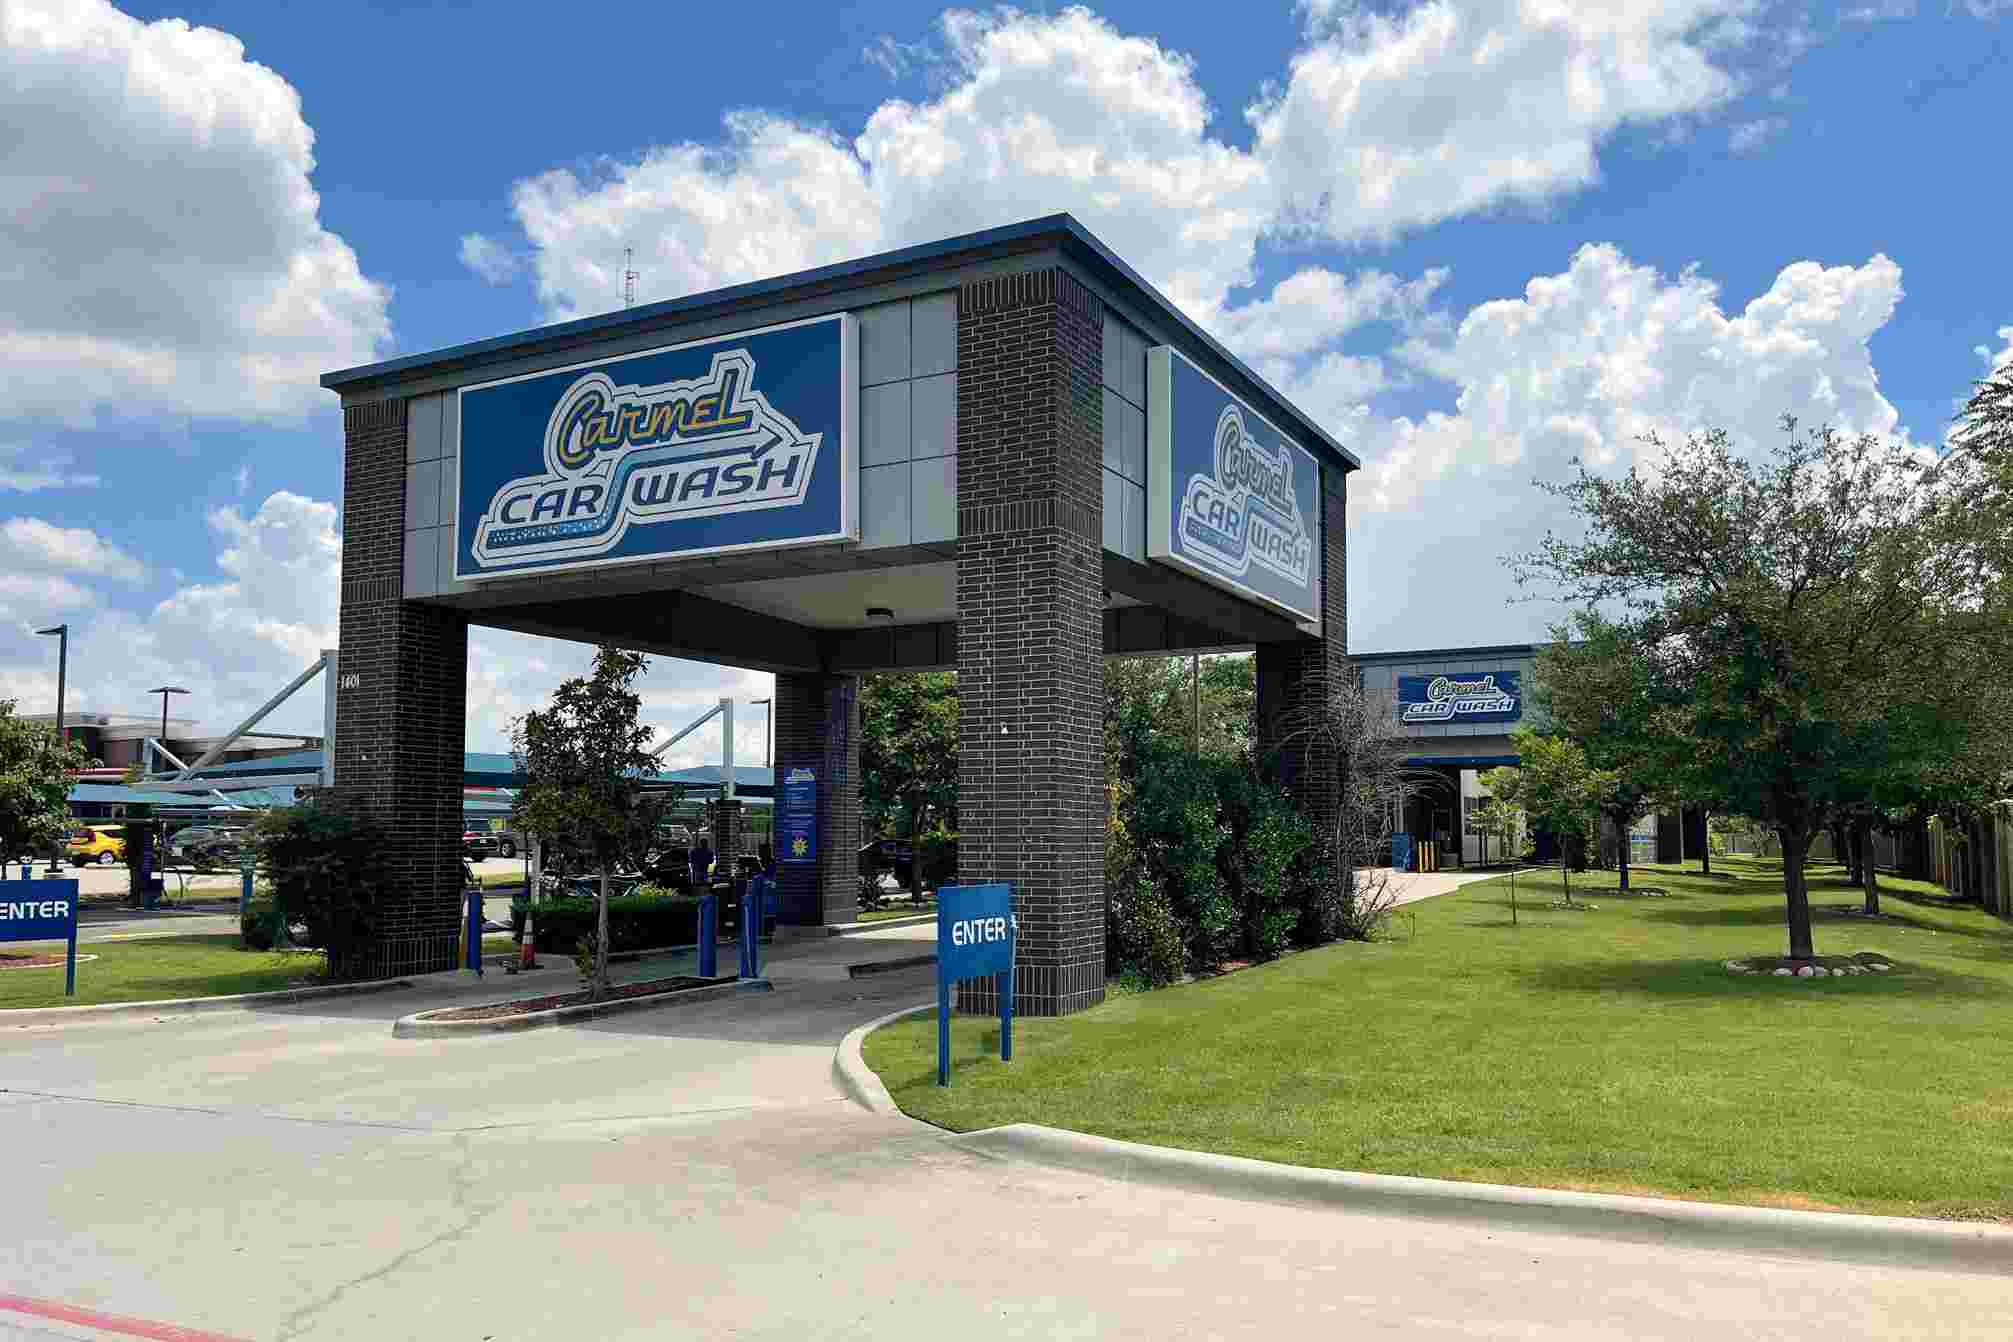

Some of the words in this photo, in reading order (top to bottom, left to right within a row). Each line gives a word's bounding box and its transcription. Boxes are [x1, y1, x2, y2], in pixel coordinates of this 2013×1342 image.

[500, 484, 603, 525] CAR
[632, 454, 800, 507] WASH
[1192, 490, 1241, 539] CAR
[1251, 519, 1307, 571] WASH
[1410, 703, 1449, 713] CAR
[1456, 700, 1514, 713] WASH
[0, 901, 69, 920] ENTER
[952, 917, 1006, 945] ENTER
